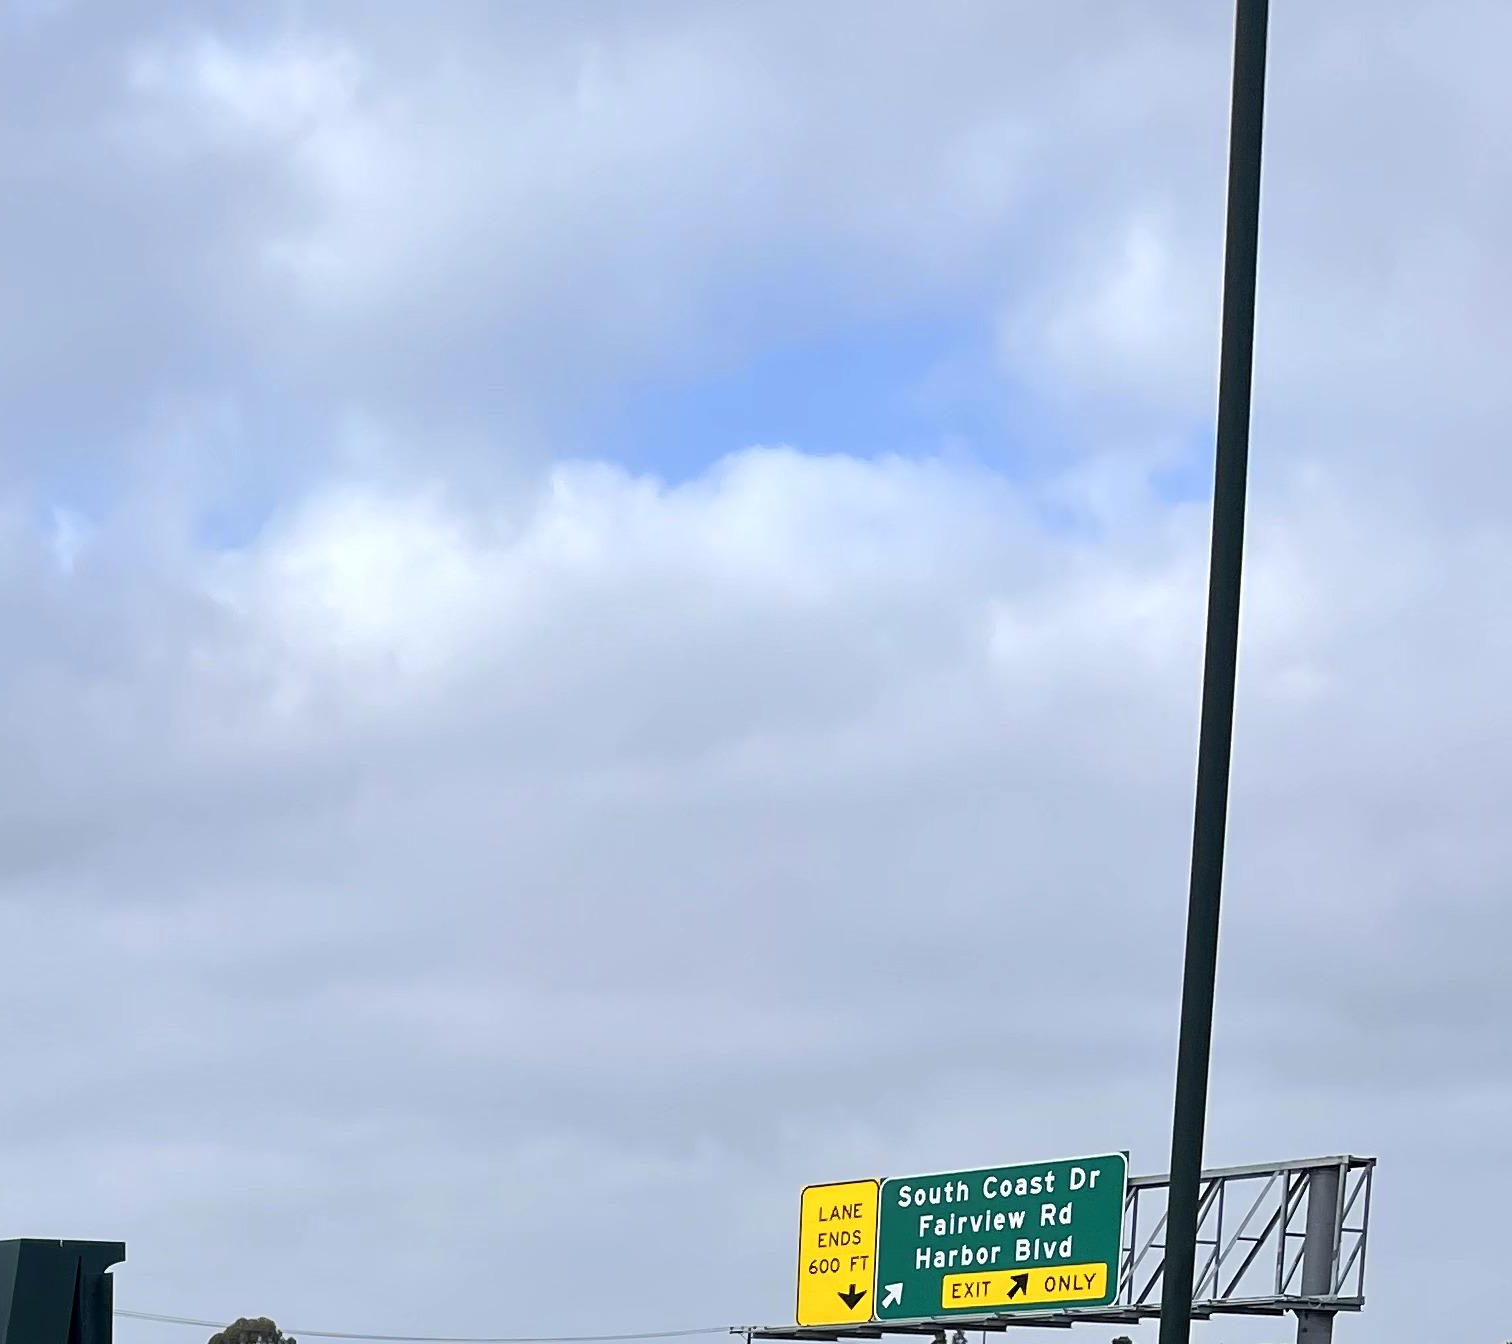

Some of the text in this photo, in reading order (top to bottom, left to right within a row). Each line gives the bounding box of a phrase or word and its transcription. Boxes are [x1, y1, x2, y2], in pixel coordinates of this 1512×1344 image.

[897, 1167, 1101, 1208] South Coast Dr
[819, 1203, 863, 1222] LANE
[919, 1202, 1073, 1237] Fairview Rd
[818, 1230, 862, 1248] ENDS
[915, 1235, 1073, 1270] Harbor Blvd
[808, 1255, 869, 1275] 600 FT
[952, 1272, 1097, 1299] EXIT ONLY
